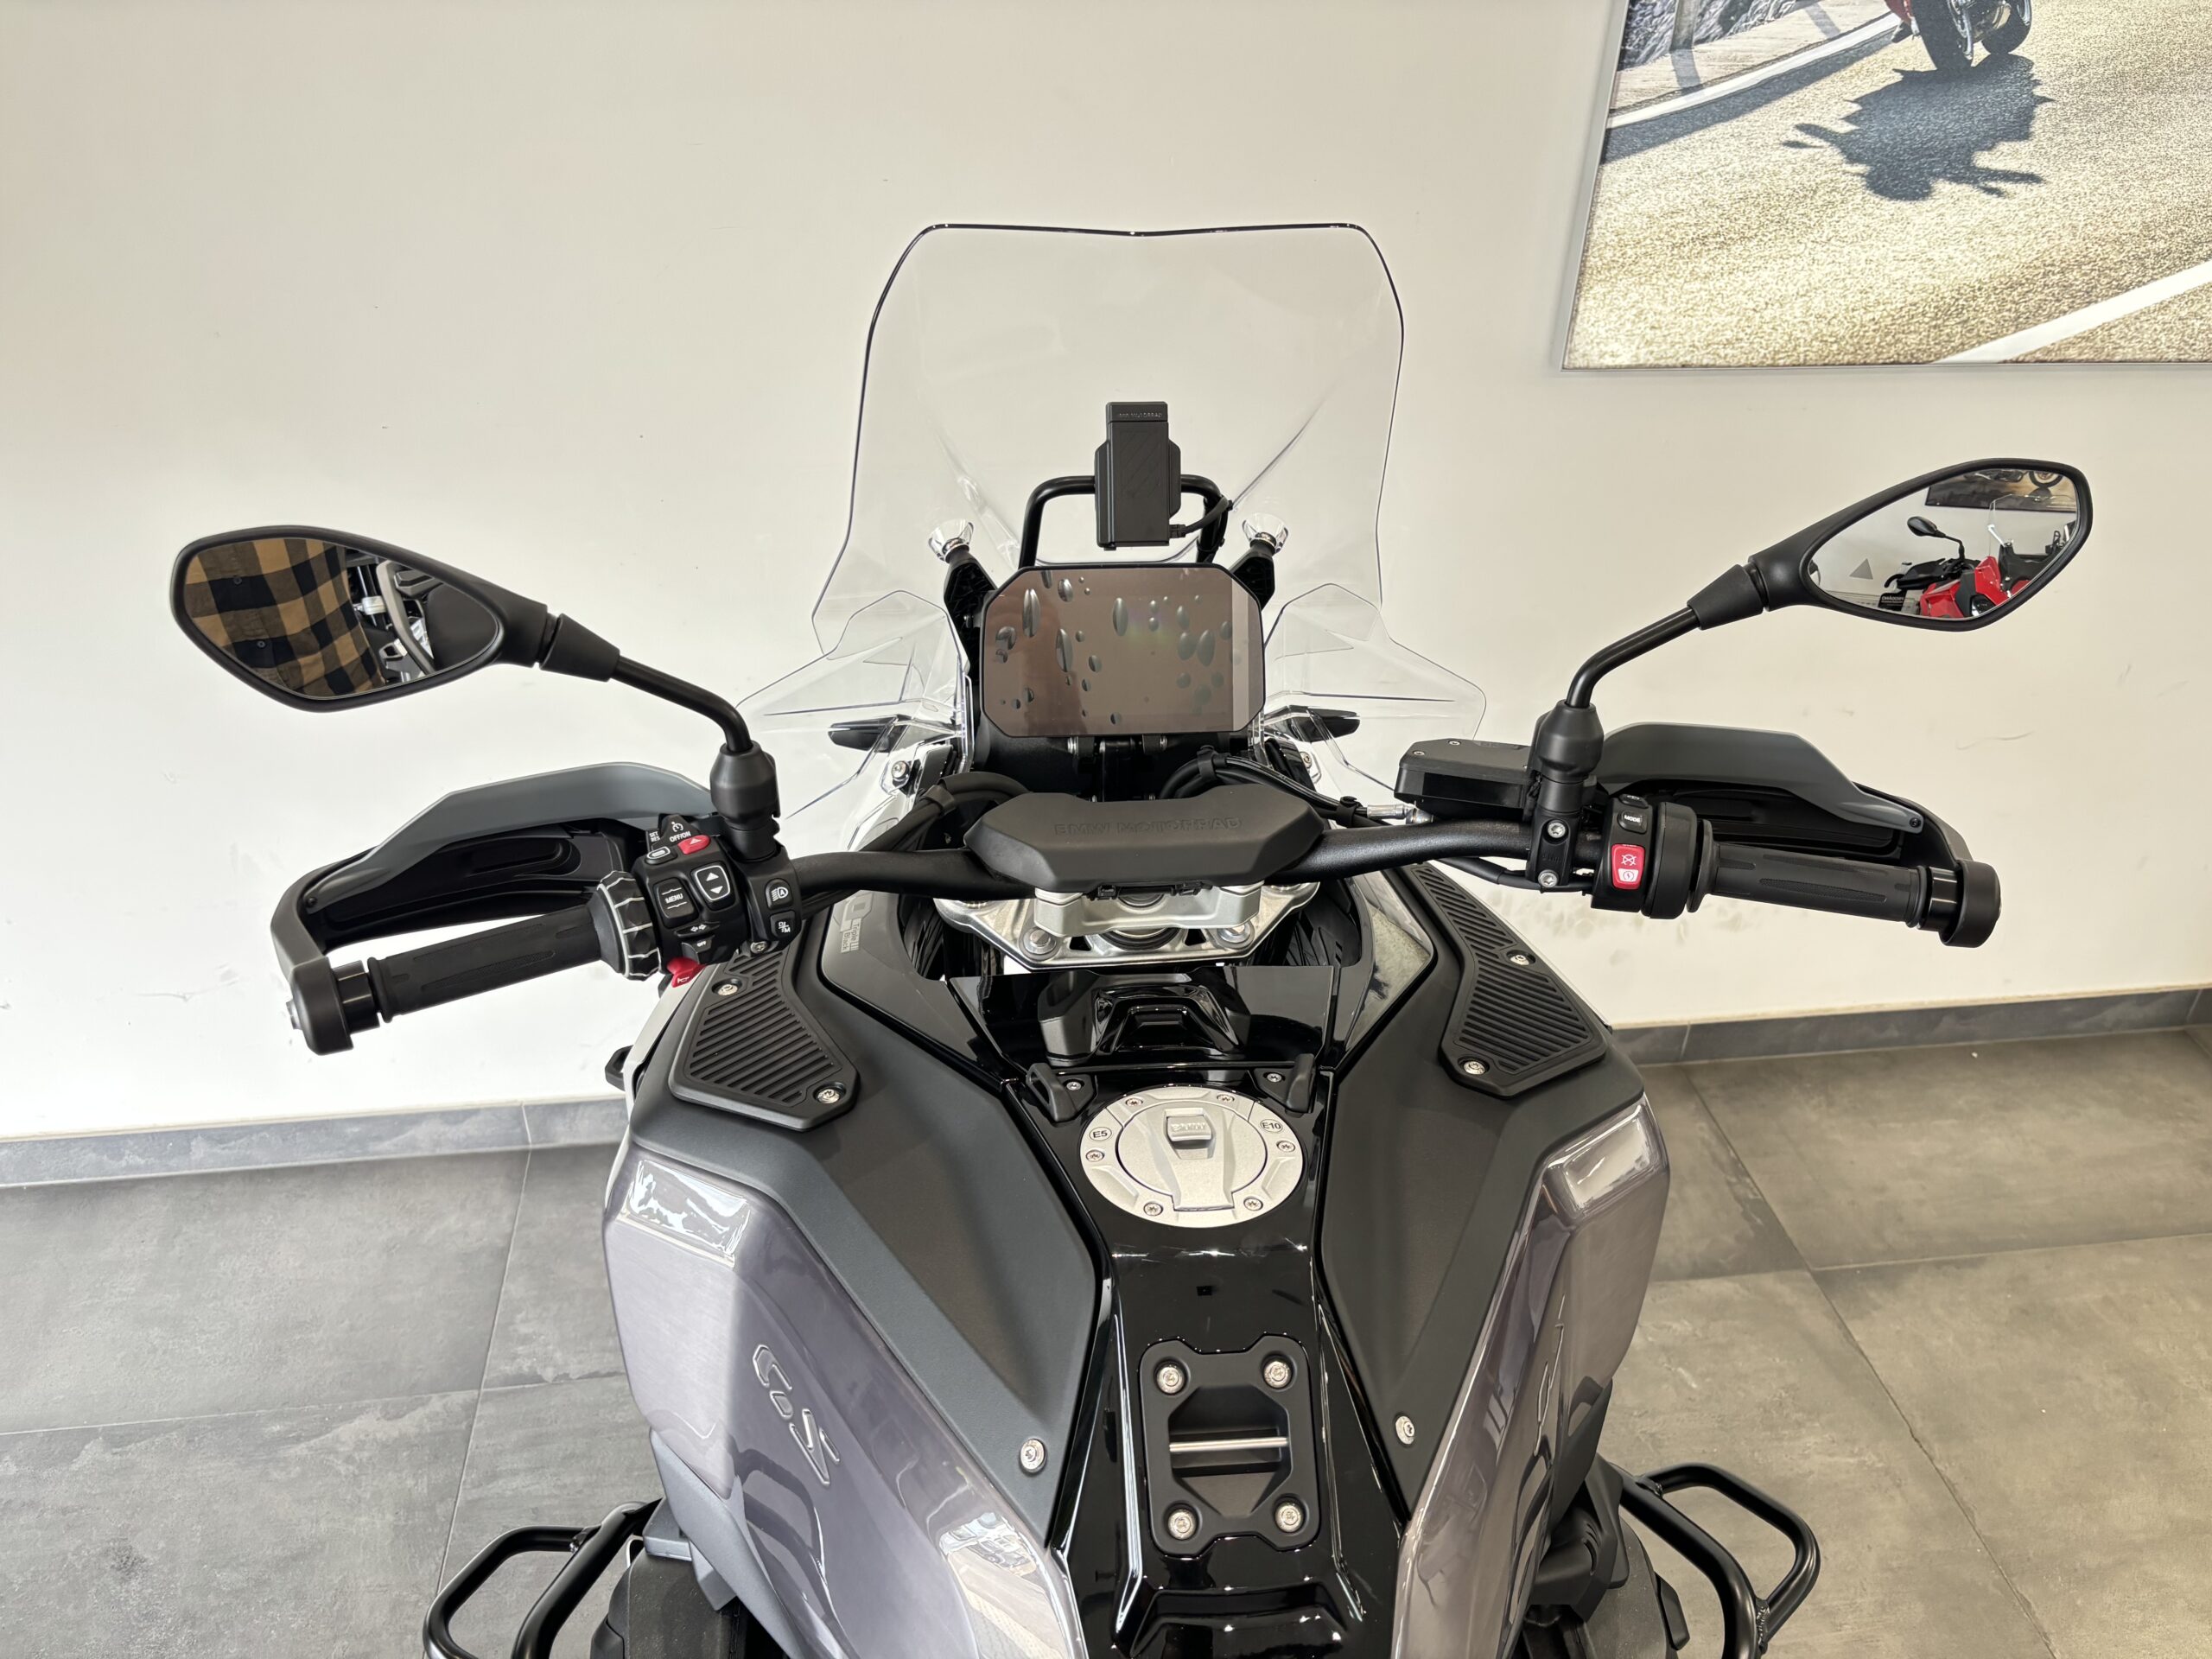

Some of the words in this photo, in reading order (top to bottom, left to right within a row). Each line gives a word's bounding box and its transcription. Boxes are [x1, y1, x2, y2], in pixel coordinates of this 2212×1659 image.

[1624, 815, 1643, 823] MODE
[1054, 822, 1110, 836] BMW
[1116, 817, 1243, 834] MOTORRAD
[670, 830, 692, 842] OFF/ON
[664, 893, 683, 904] MENU
[850, 923, 860, 942] Triple
[842, 932, 851, 950] Black
[1262, 1120, 1281, 1130] E10
[1092, 1129, 1108, 1138] E5
